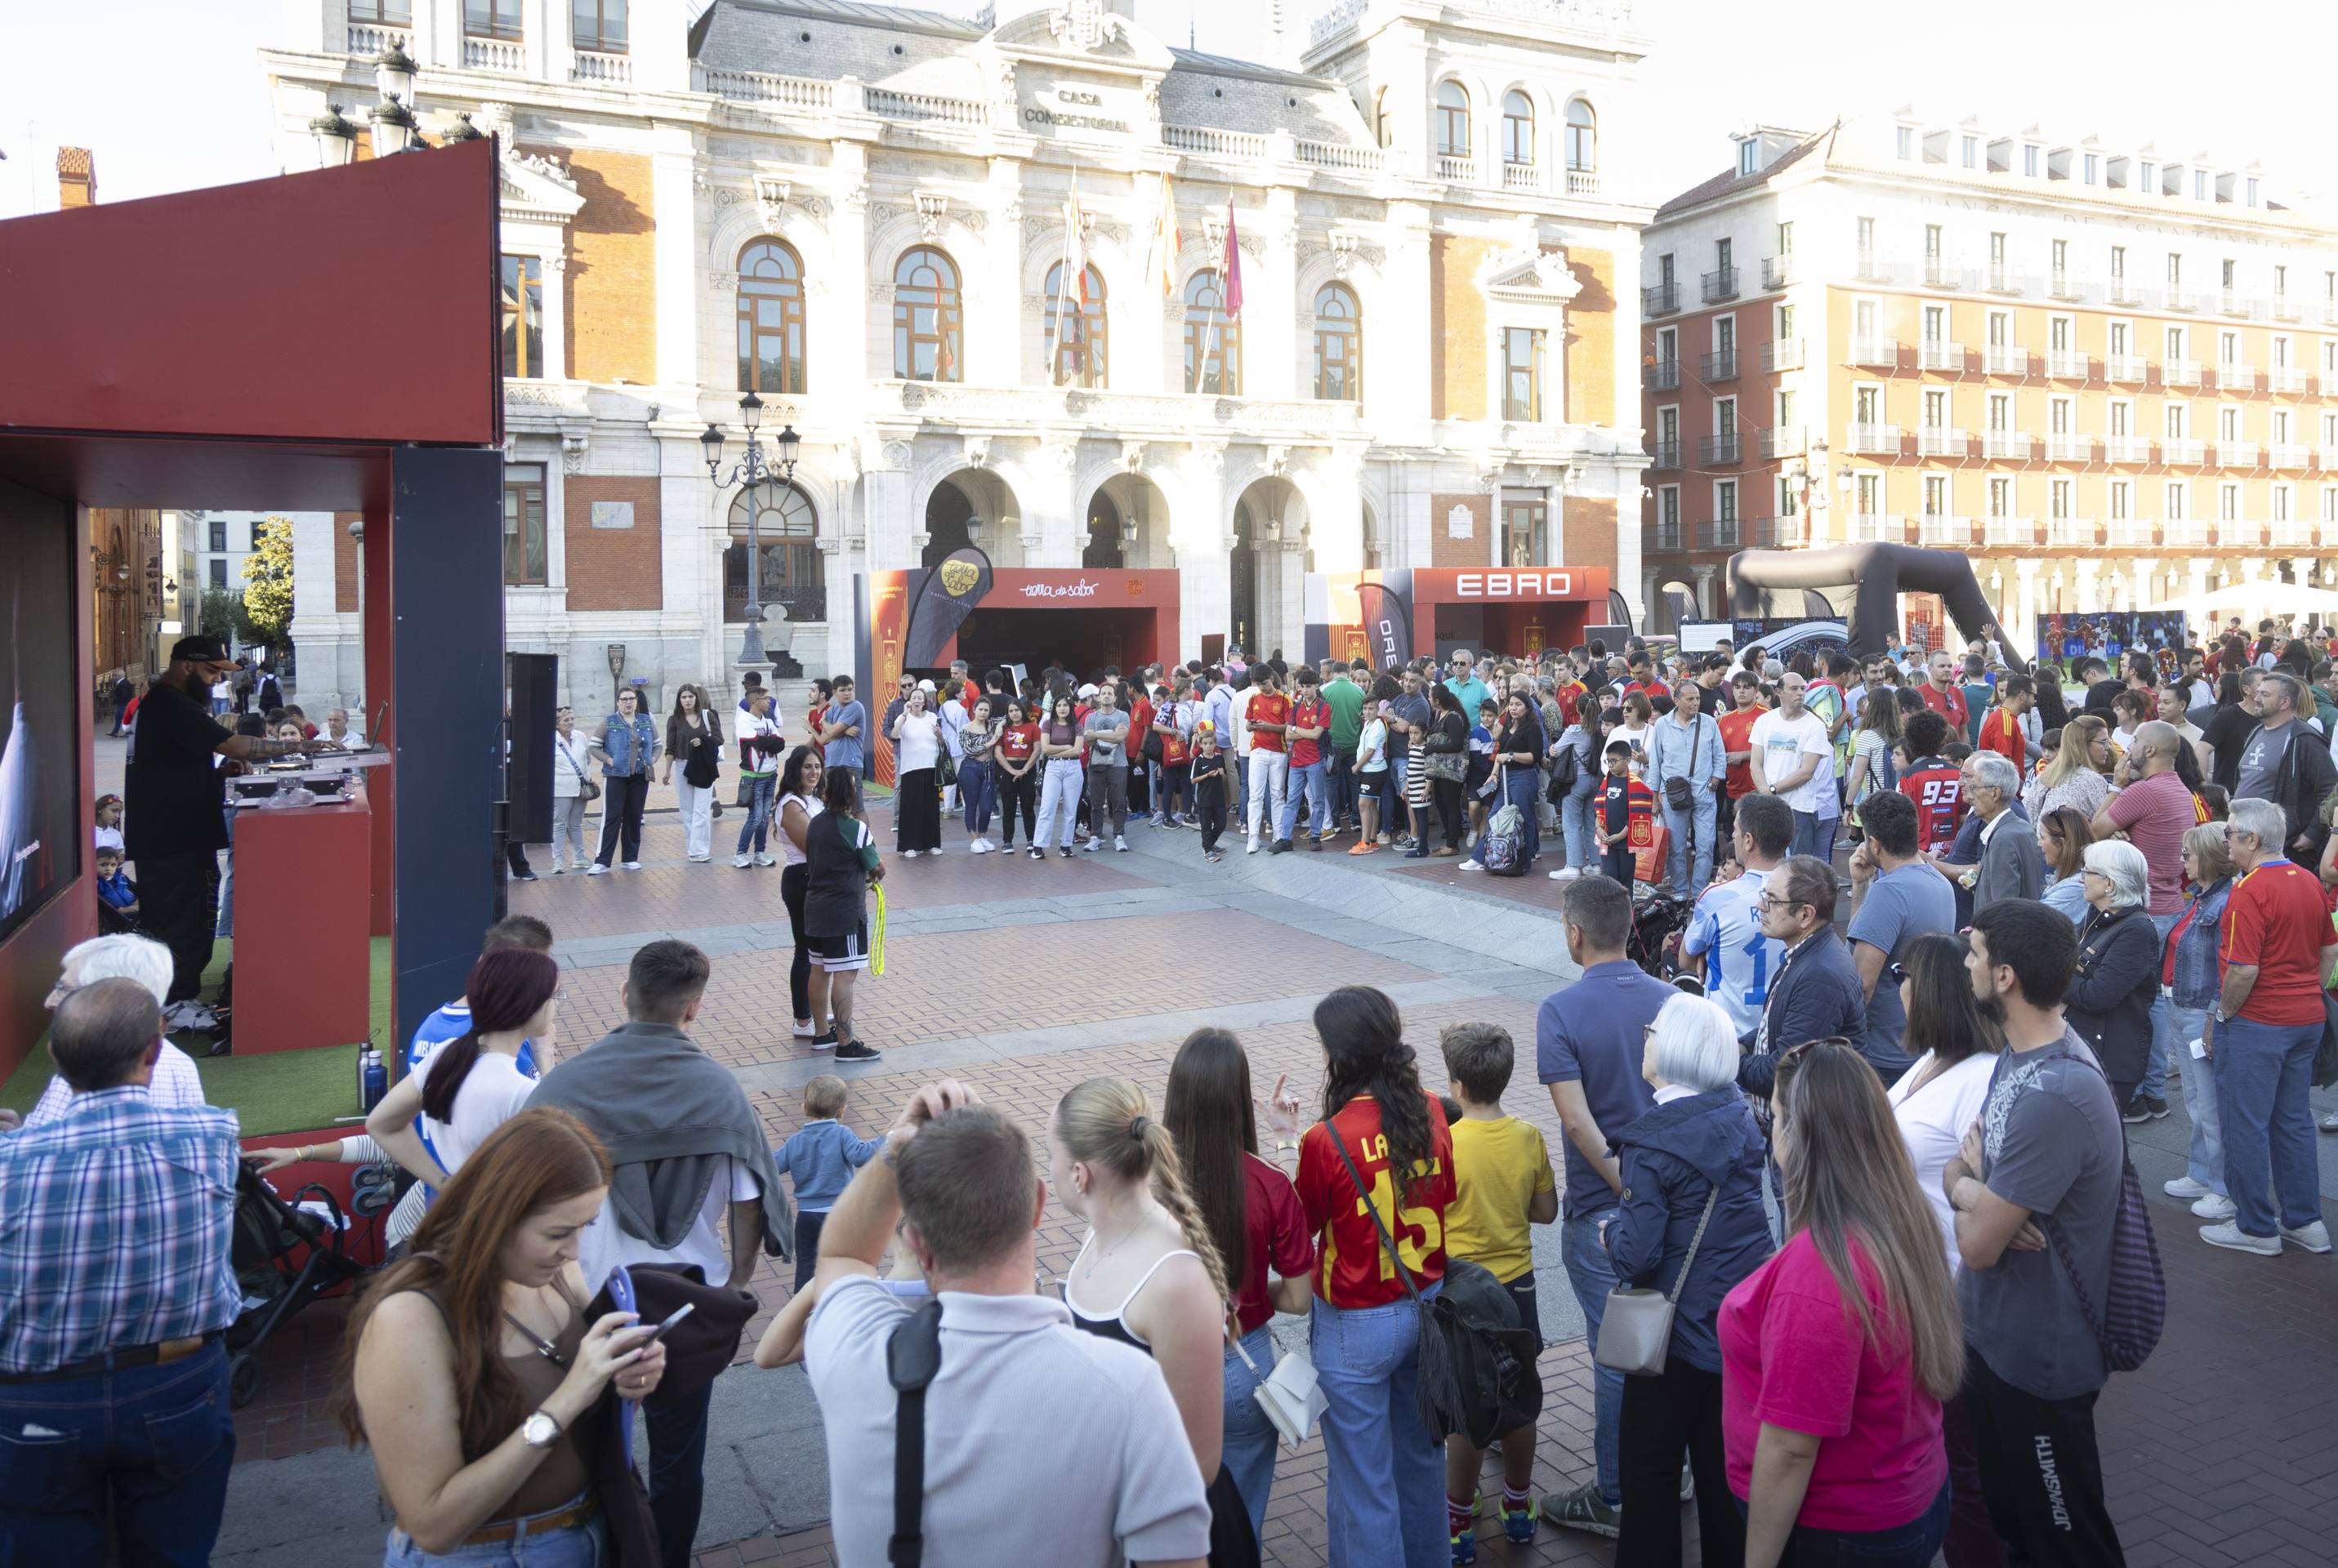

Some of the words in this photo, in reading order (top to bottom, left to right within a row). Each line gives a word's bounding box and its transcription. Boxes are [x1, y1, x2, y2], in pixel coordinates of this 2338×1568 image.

[1059, 90, 1103, 106] CASA
[1024, 109, 1131, 132] CONSISTORIAL
[1067, 578, 1100, 597] sabor
[1457, 573, 1571, 596] EBRO
[1380, 619, 1398, 670] BRO
[1921, 780, 1960, 807] 93
[1361, 1134, 1390, 1163] LA
[1357, 1156, 1441, 1282] 15
[2034, 1435, 2073, 1531] JOHNSMITH
